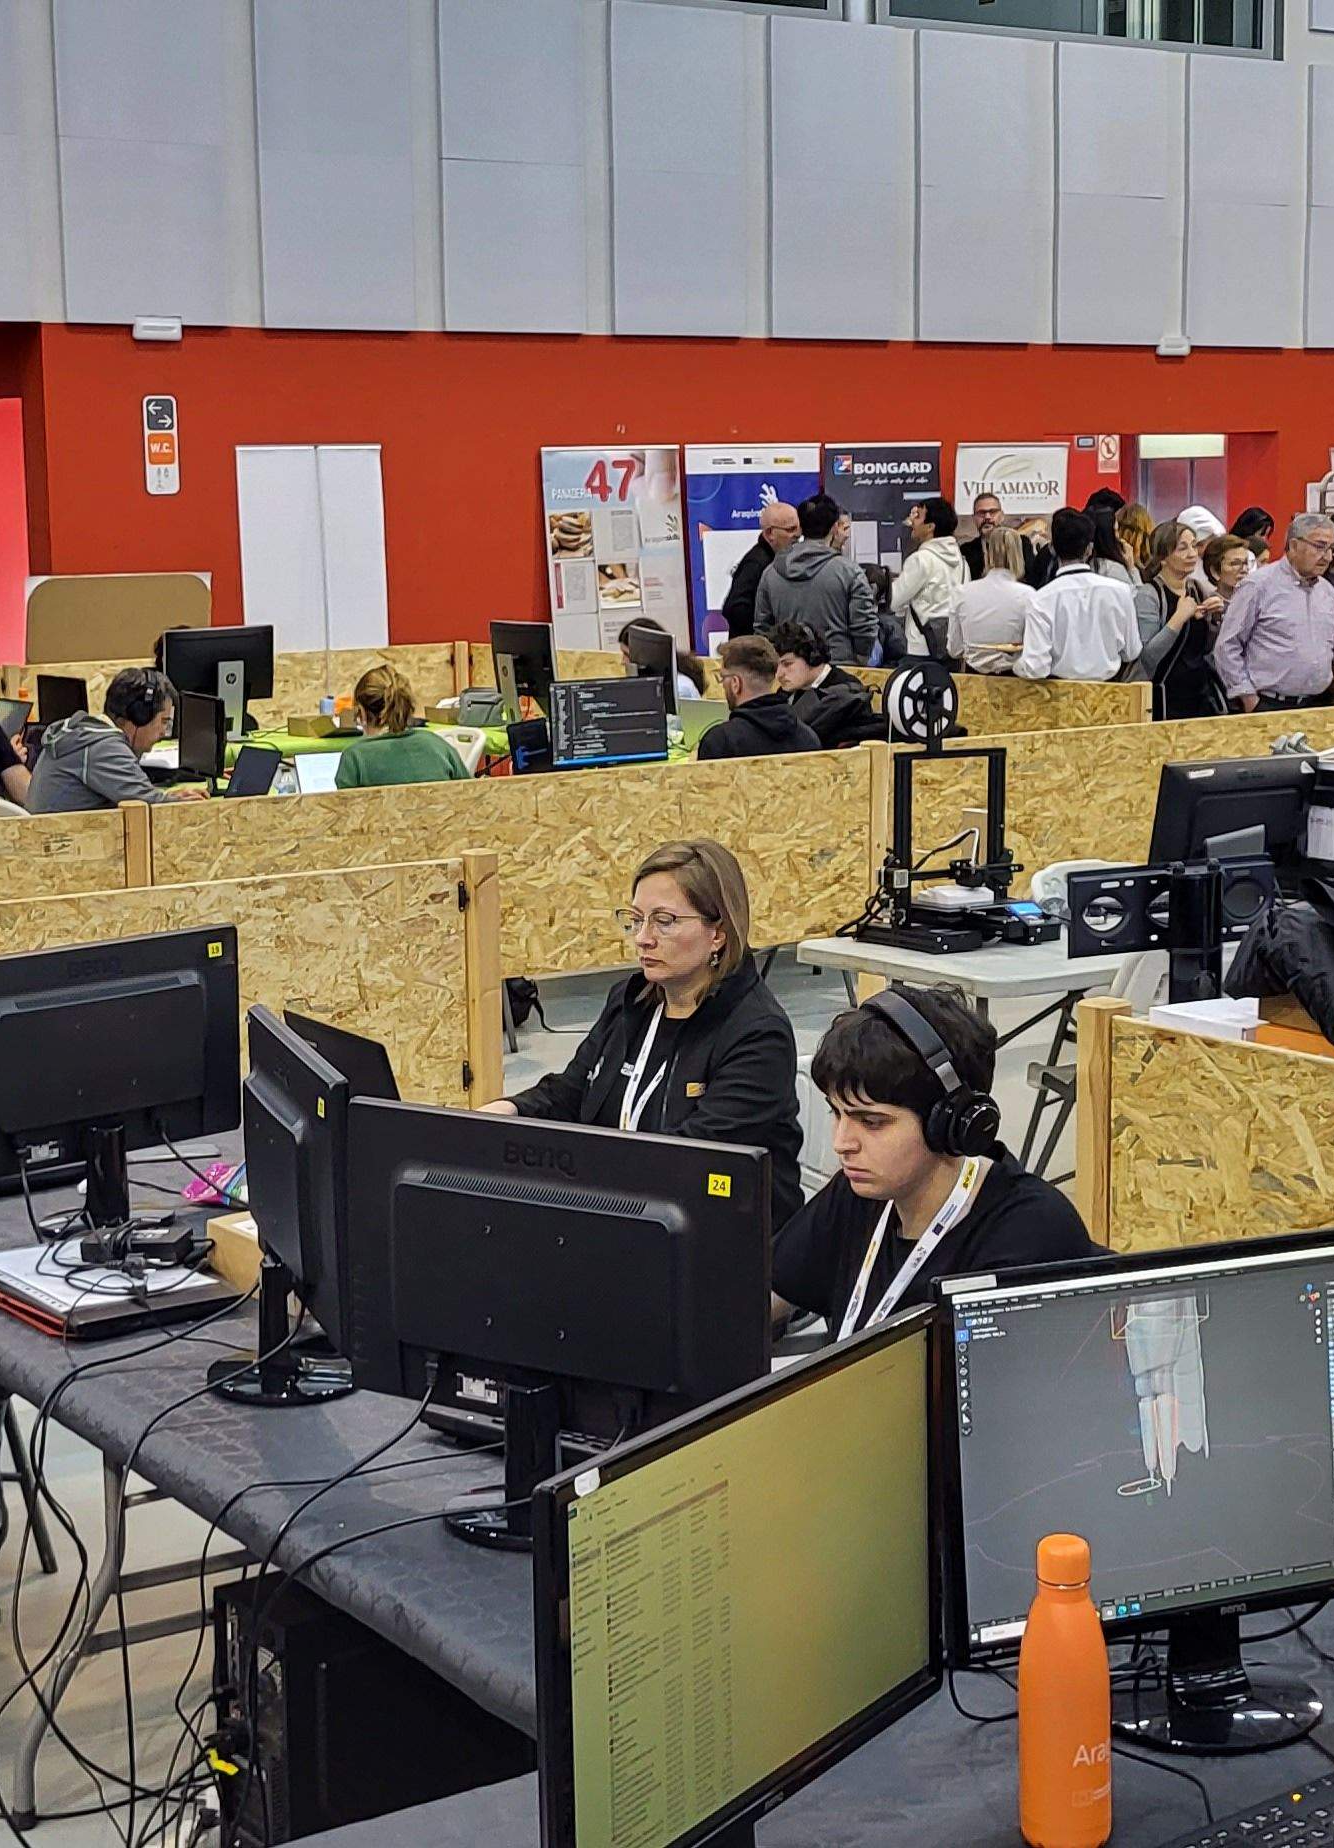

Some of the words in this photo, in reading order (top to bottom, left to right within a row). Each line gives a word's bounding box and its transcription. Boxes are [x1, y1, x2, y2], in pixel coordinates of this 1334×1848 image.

[150, 442, 173, 453] W.C.
[853, 462, 933, 475] BONGARD
[584, 459, 637, 503] 47
[712, 1179, 726, 1192] 24
[1072, 1740, 1111, 1768] Ara
